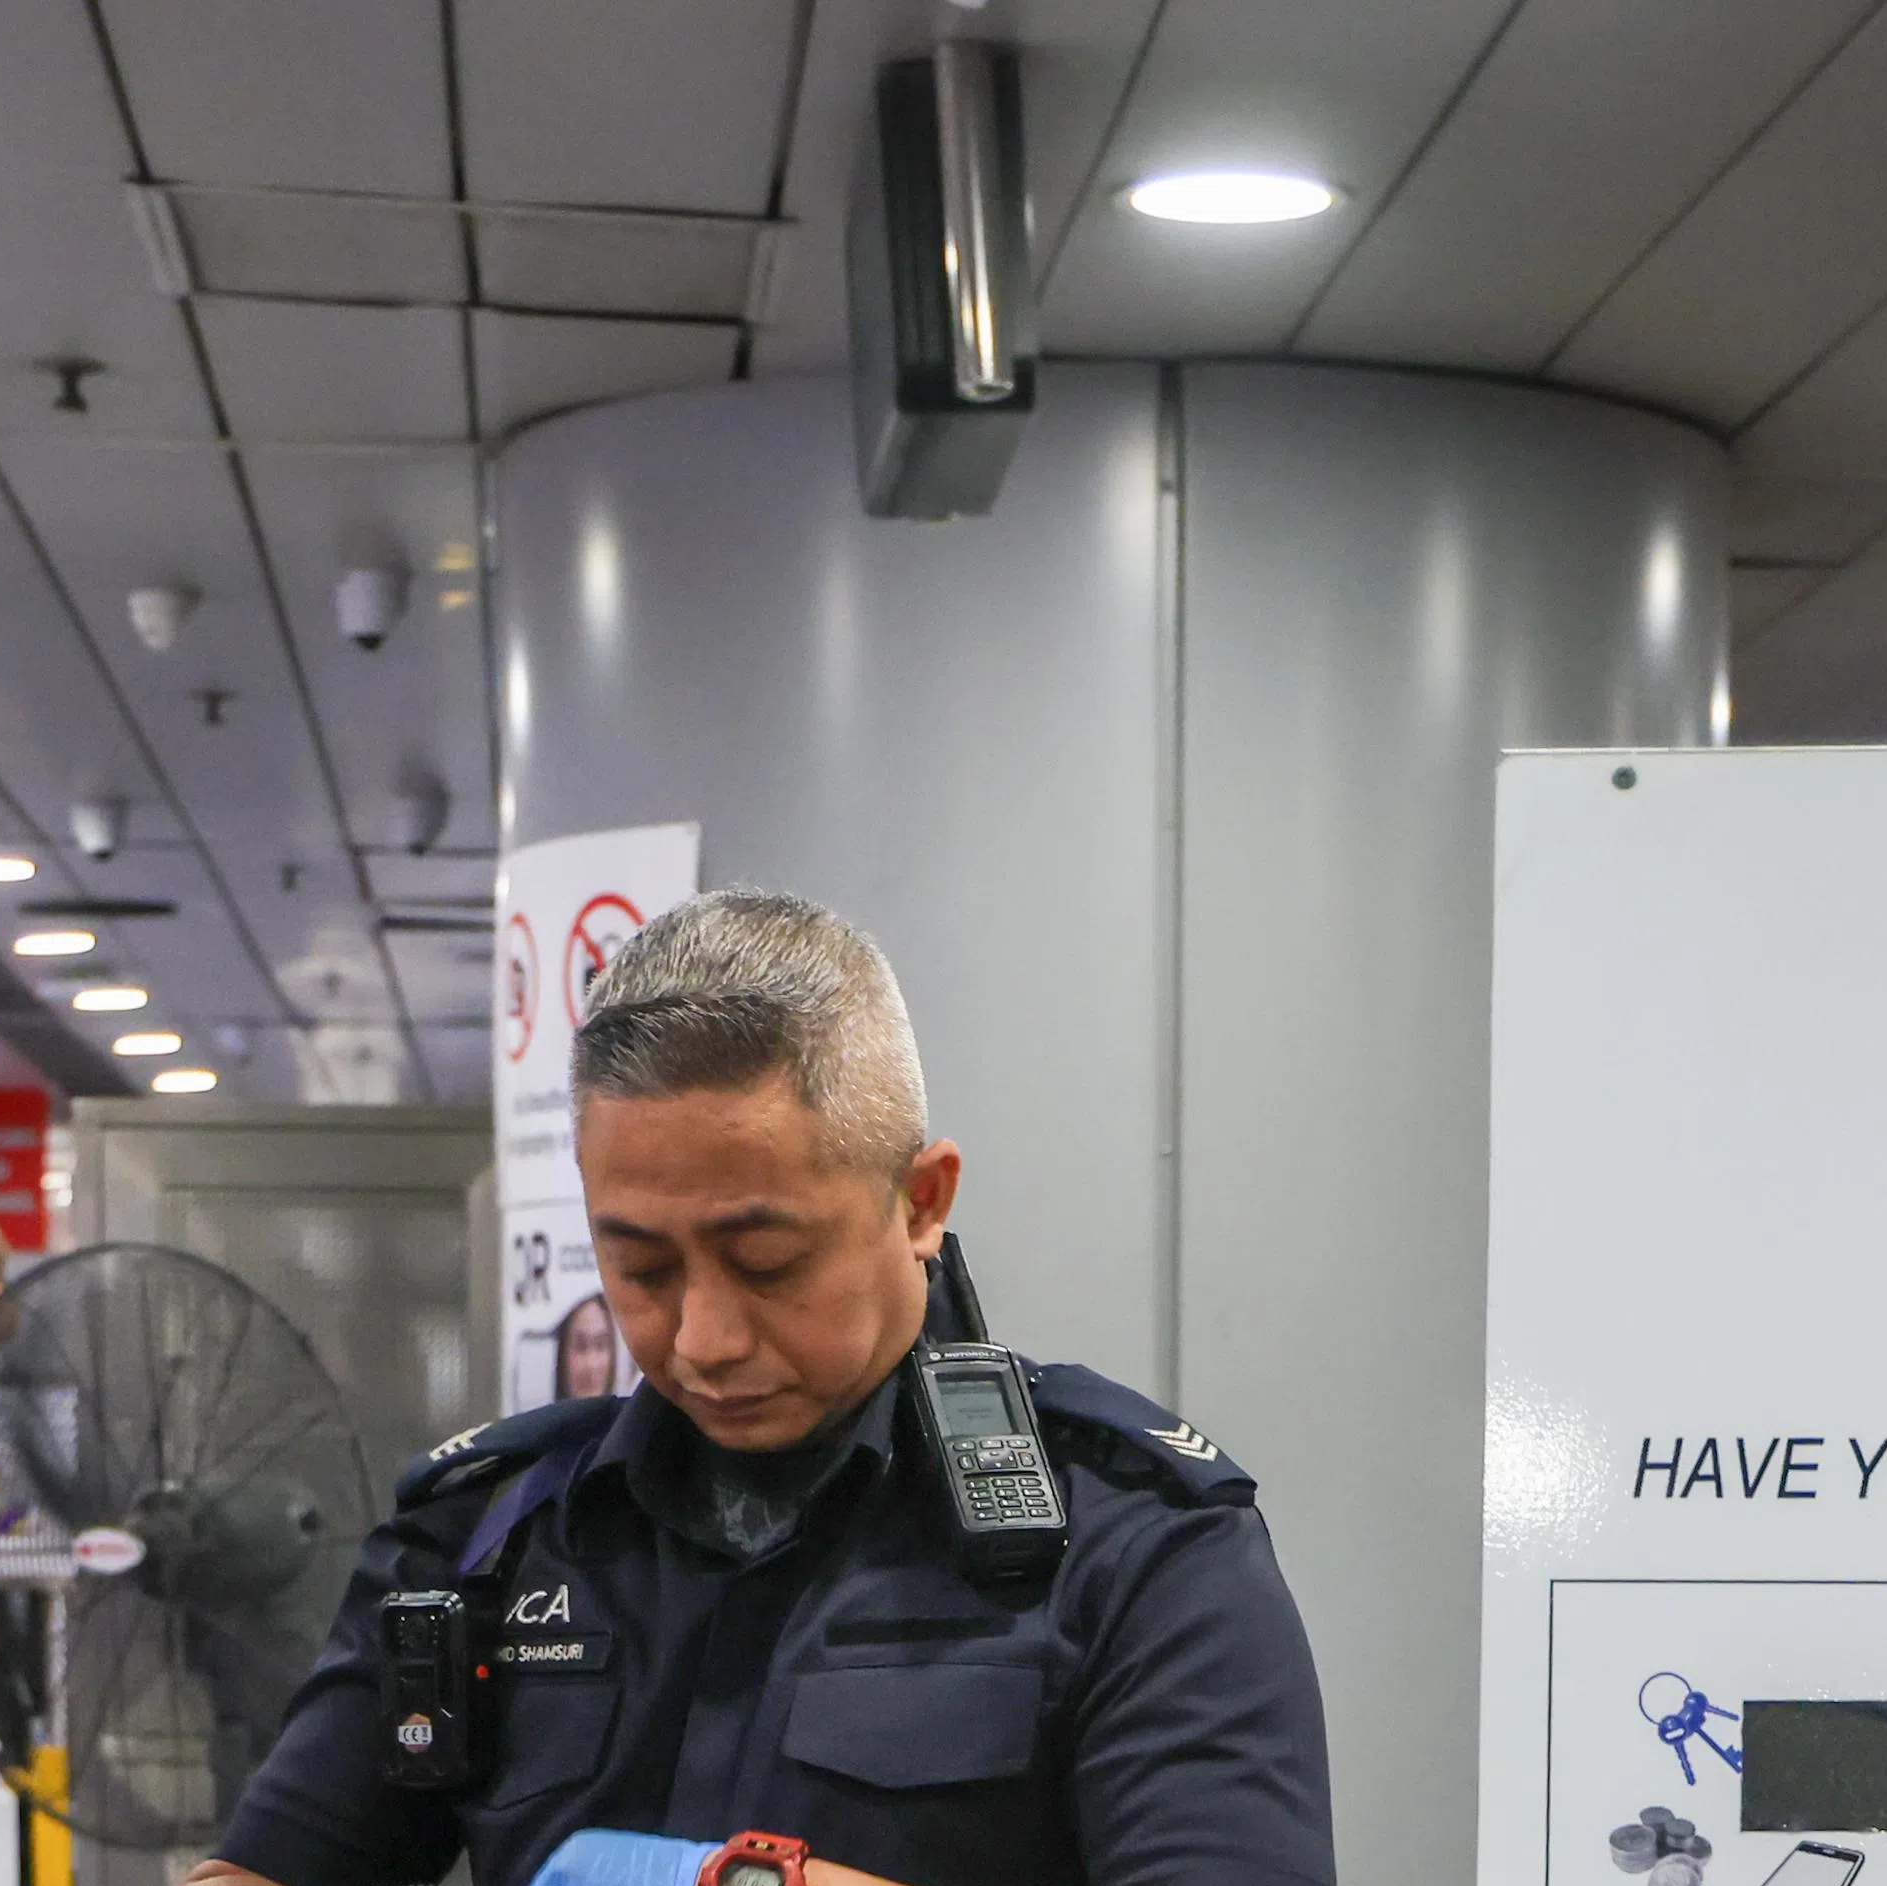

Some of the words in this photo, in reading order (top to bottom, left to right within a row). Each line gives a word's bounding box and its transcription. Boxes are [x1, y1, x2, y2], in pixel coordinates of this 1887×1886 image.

[944, 1351, 998, 1359] MOTOROLA
[1634, 1438, 1824, 1498] HAVE
[505, 1584, 571, 1624] ICA
[518, 1643, 585, 1662] SHAMSURI
